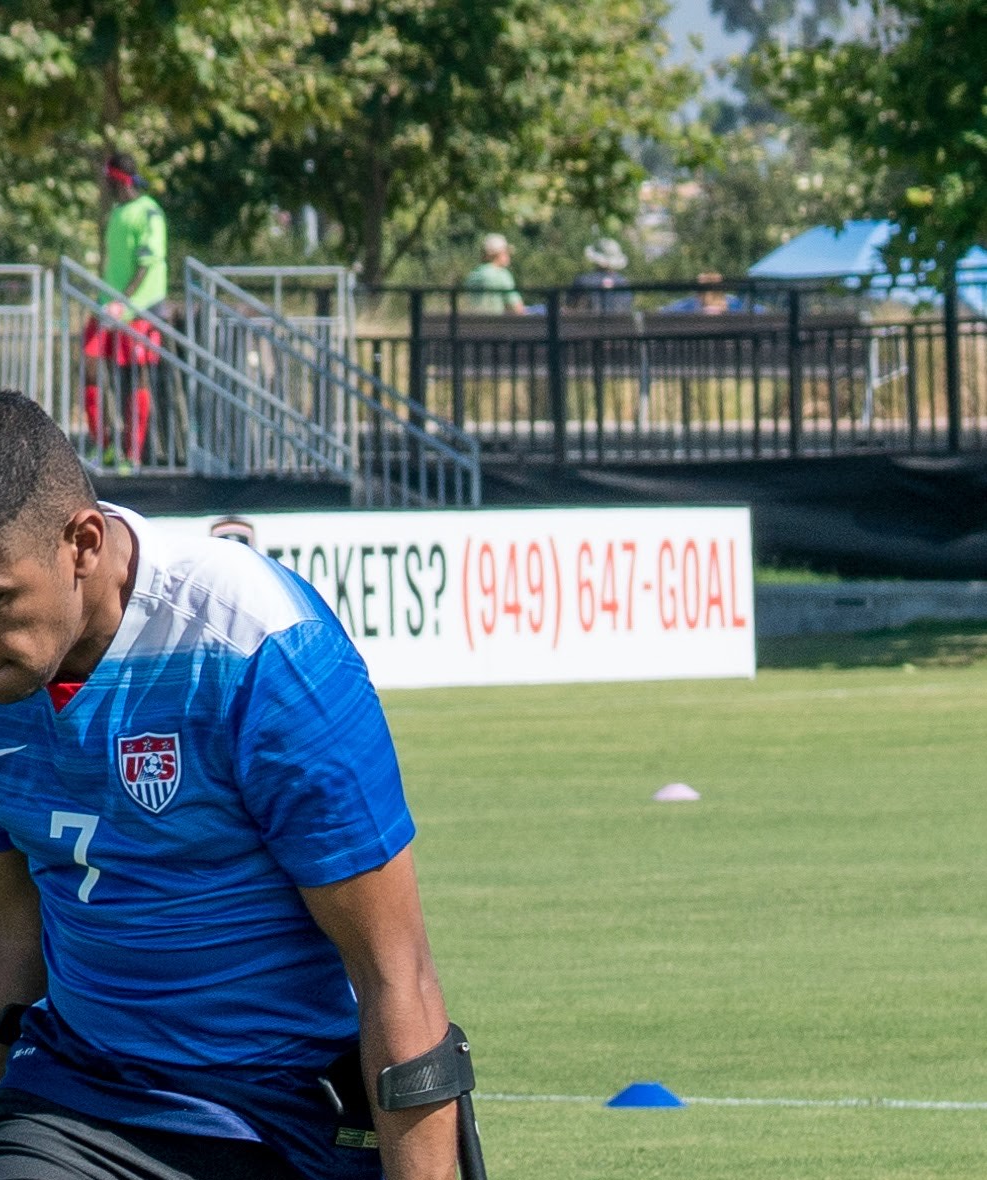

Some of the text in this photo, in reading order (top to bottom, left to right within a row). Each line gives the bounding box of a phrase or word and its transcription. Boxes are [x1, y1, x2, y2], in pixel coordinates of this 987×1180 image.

[267, 536, 746, 650] KETS? (949) 647-GOAL
[49, 811, 100, 903] 7
